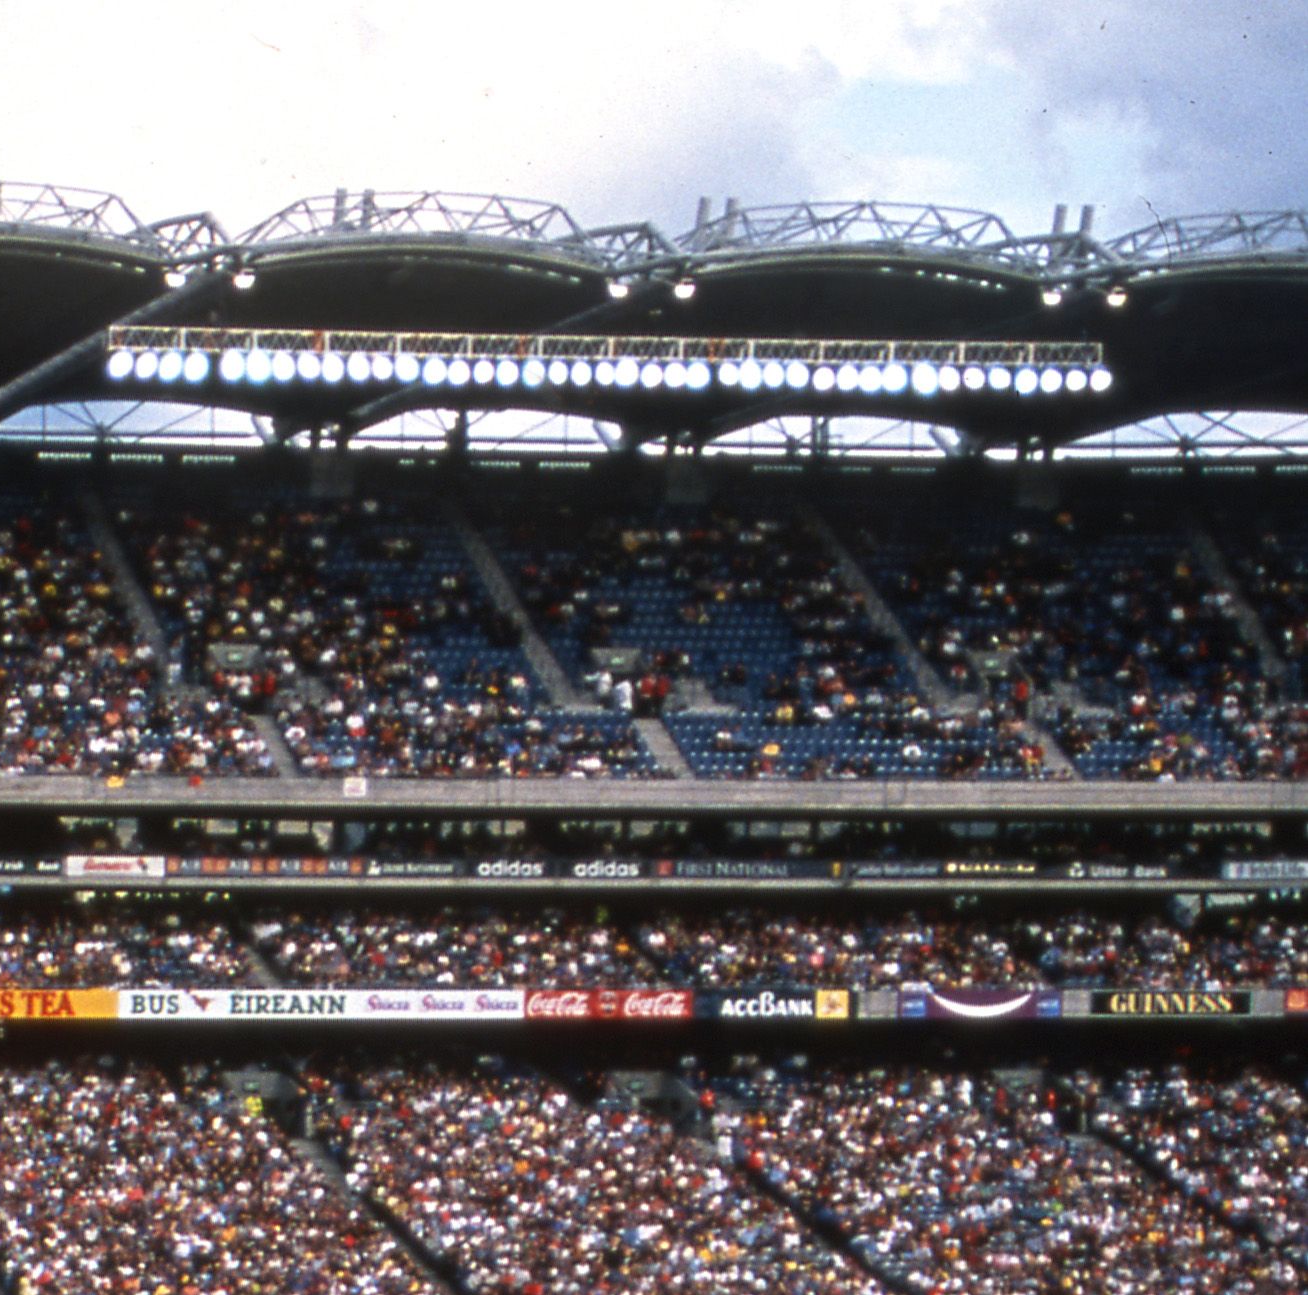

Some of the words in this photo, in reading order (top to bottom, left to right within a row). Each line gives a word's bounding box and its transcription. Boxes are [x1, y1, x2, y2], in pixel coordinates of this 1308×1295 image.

[478, 860, 543, 876] adidas
[574, 862, 639, 878] adidas
[22, 993, 75, 1015] TEA
[130, 994, 180, 1015] BUS
[1110, 993, 1232, 1014] GUINNESS
